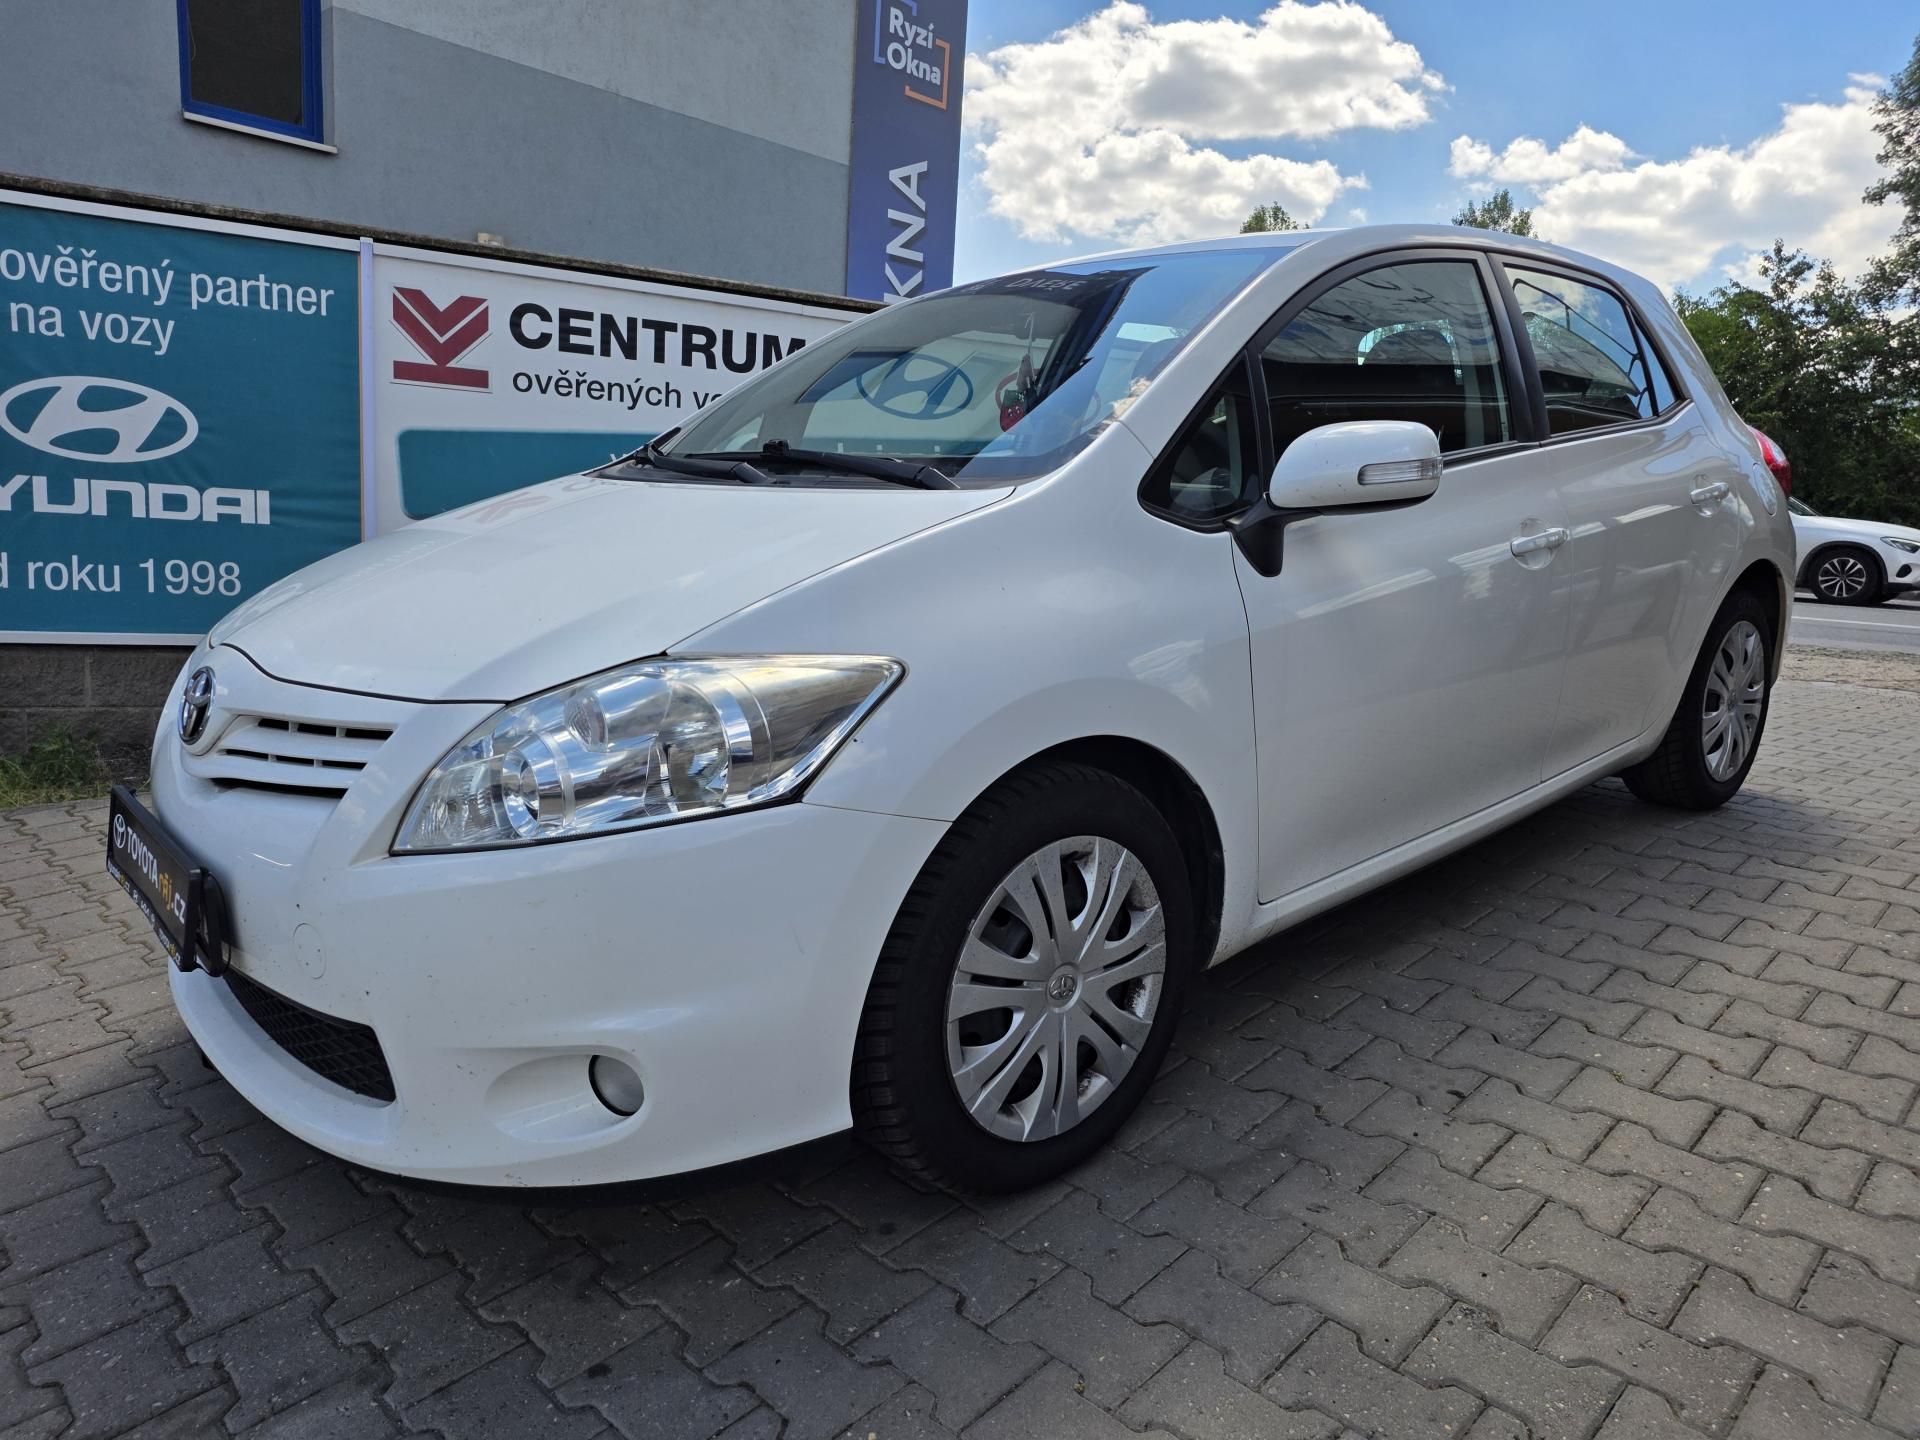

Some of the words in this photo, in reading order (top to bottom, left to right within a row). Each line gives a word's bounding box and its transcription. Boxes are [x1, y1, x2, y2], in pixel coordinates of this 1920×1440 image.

[886, 42, 941, 86] Okna
[0, 245, 174, 306] ověřený
[190, 272, 334, 317] partner
[10, 301, 64, 338] na
[79, 310, 175, 356] vozy
[509, 302, 806, 374] CENTRUM
[511, 370, 682, 411] ověřených
[27, 554, 121, 594] roku
[139, 559, 242, 596] 1998
